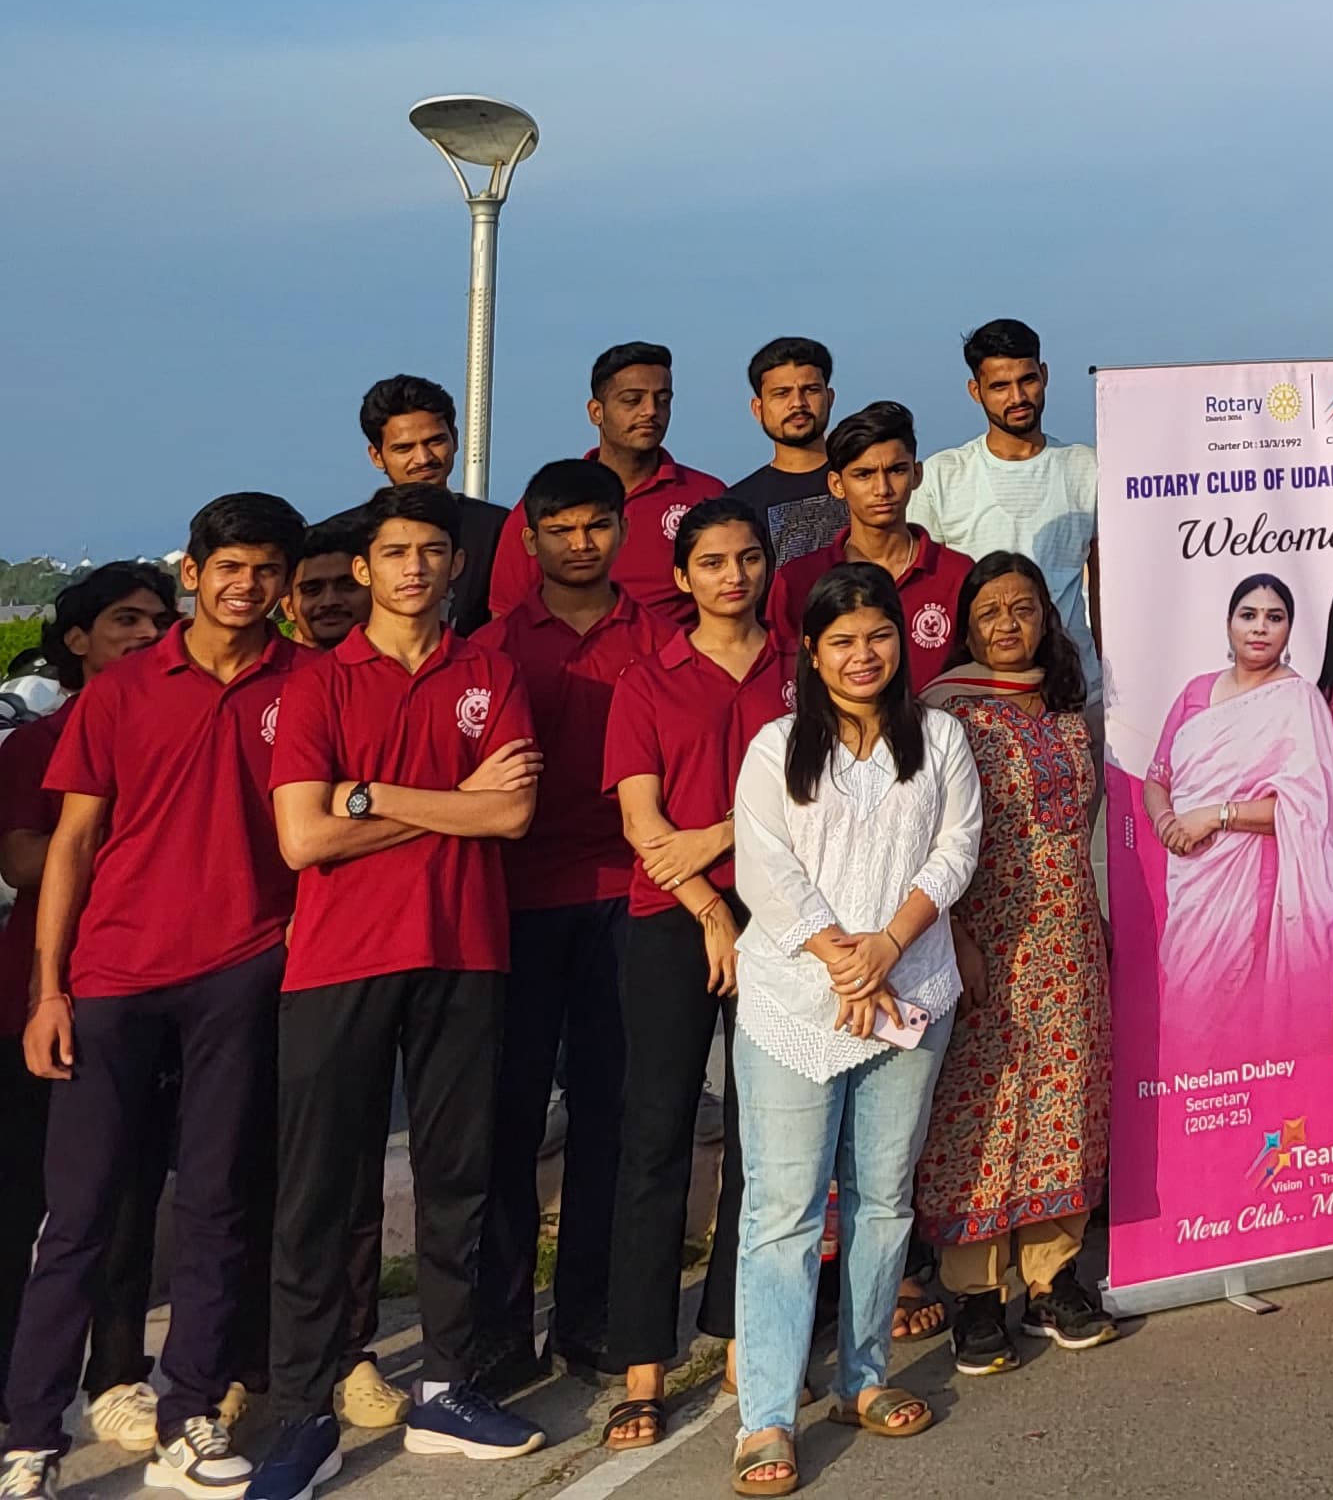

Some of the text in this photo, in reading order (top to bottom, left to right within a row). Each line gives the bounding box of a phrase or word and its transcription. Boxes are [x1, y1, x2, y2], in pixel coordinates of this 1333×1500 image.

[1206, 396, 1263, 414] Rotary
[1208, 442, 1241, 451] Charter
[1126, 473, 1200, 500] ROTARY
[1207, 469, 1257, 494] CLUB
[1263, 468, 1285, 491] OF
[1138, 1060, 1295, 1099] Rtn. Neelam Dubey
[1185, 1092, 1250, 1113] Secretary
[1185, 1108, 1252, 1136] (2024-25)
[1272, 1179, 1303, 1194] Vision
[1176, 1216, 1231, 1244] Mera
